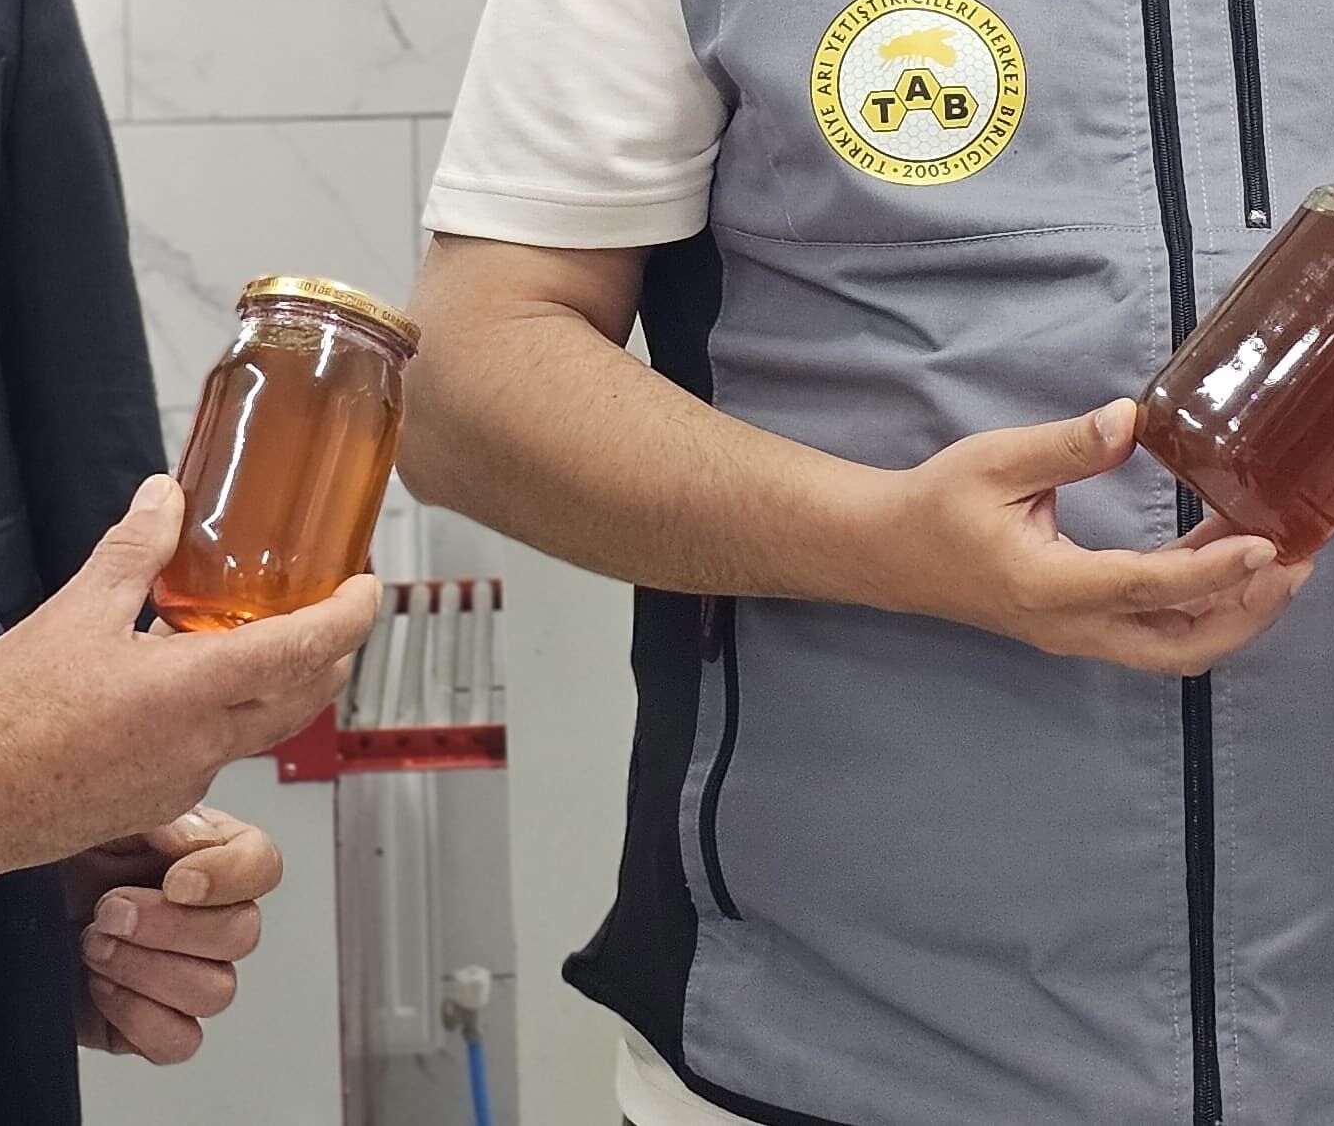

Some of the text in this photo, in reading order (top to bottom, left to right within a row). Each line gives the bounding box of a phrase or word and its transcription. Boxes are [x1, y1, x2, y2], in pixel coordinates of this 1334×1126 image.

[817, 61, 832, 96] ARI
[979, 18, 1019, 96] MERKEZ
[870, 74, 970, 124] TAB
[902, 163, 952, 178] 2003
